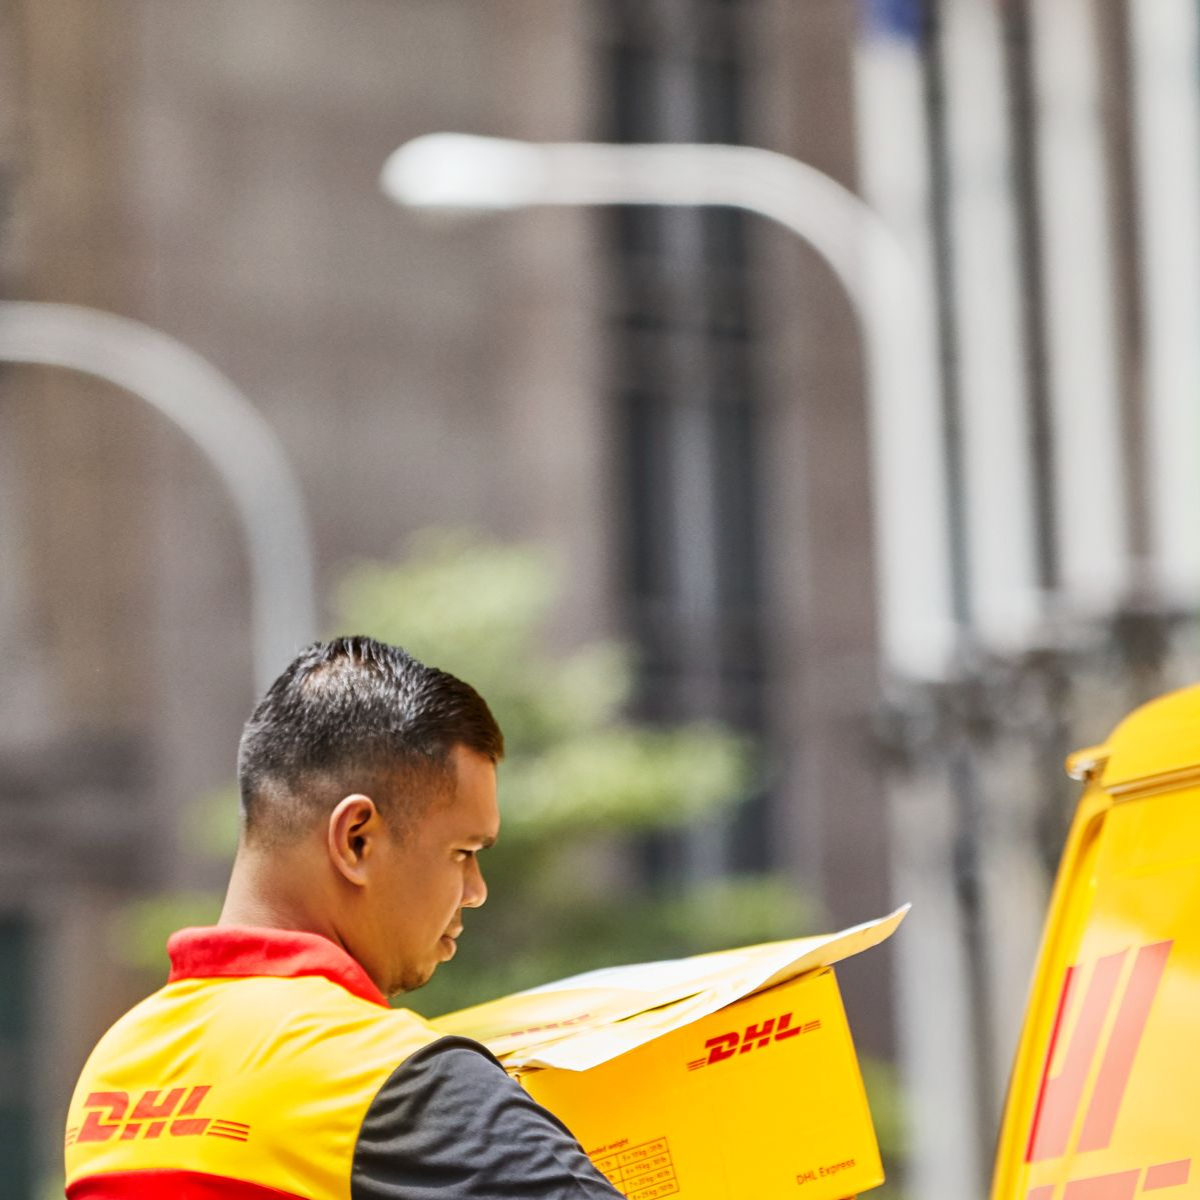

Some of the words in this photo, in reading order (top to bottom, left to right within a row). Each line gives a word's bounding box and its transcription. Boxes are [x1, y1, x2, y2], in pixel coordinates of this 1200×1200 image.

[704, 1012, 802, 1065] DHL
[76, 1085, 213, 1143] DHL
[796, 1170, 817, 1185] DHL
[819, 1158, 856, 1178] Express
